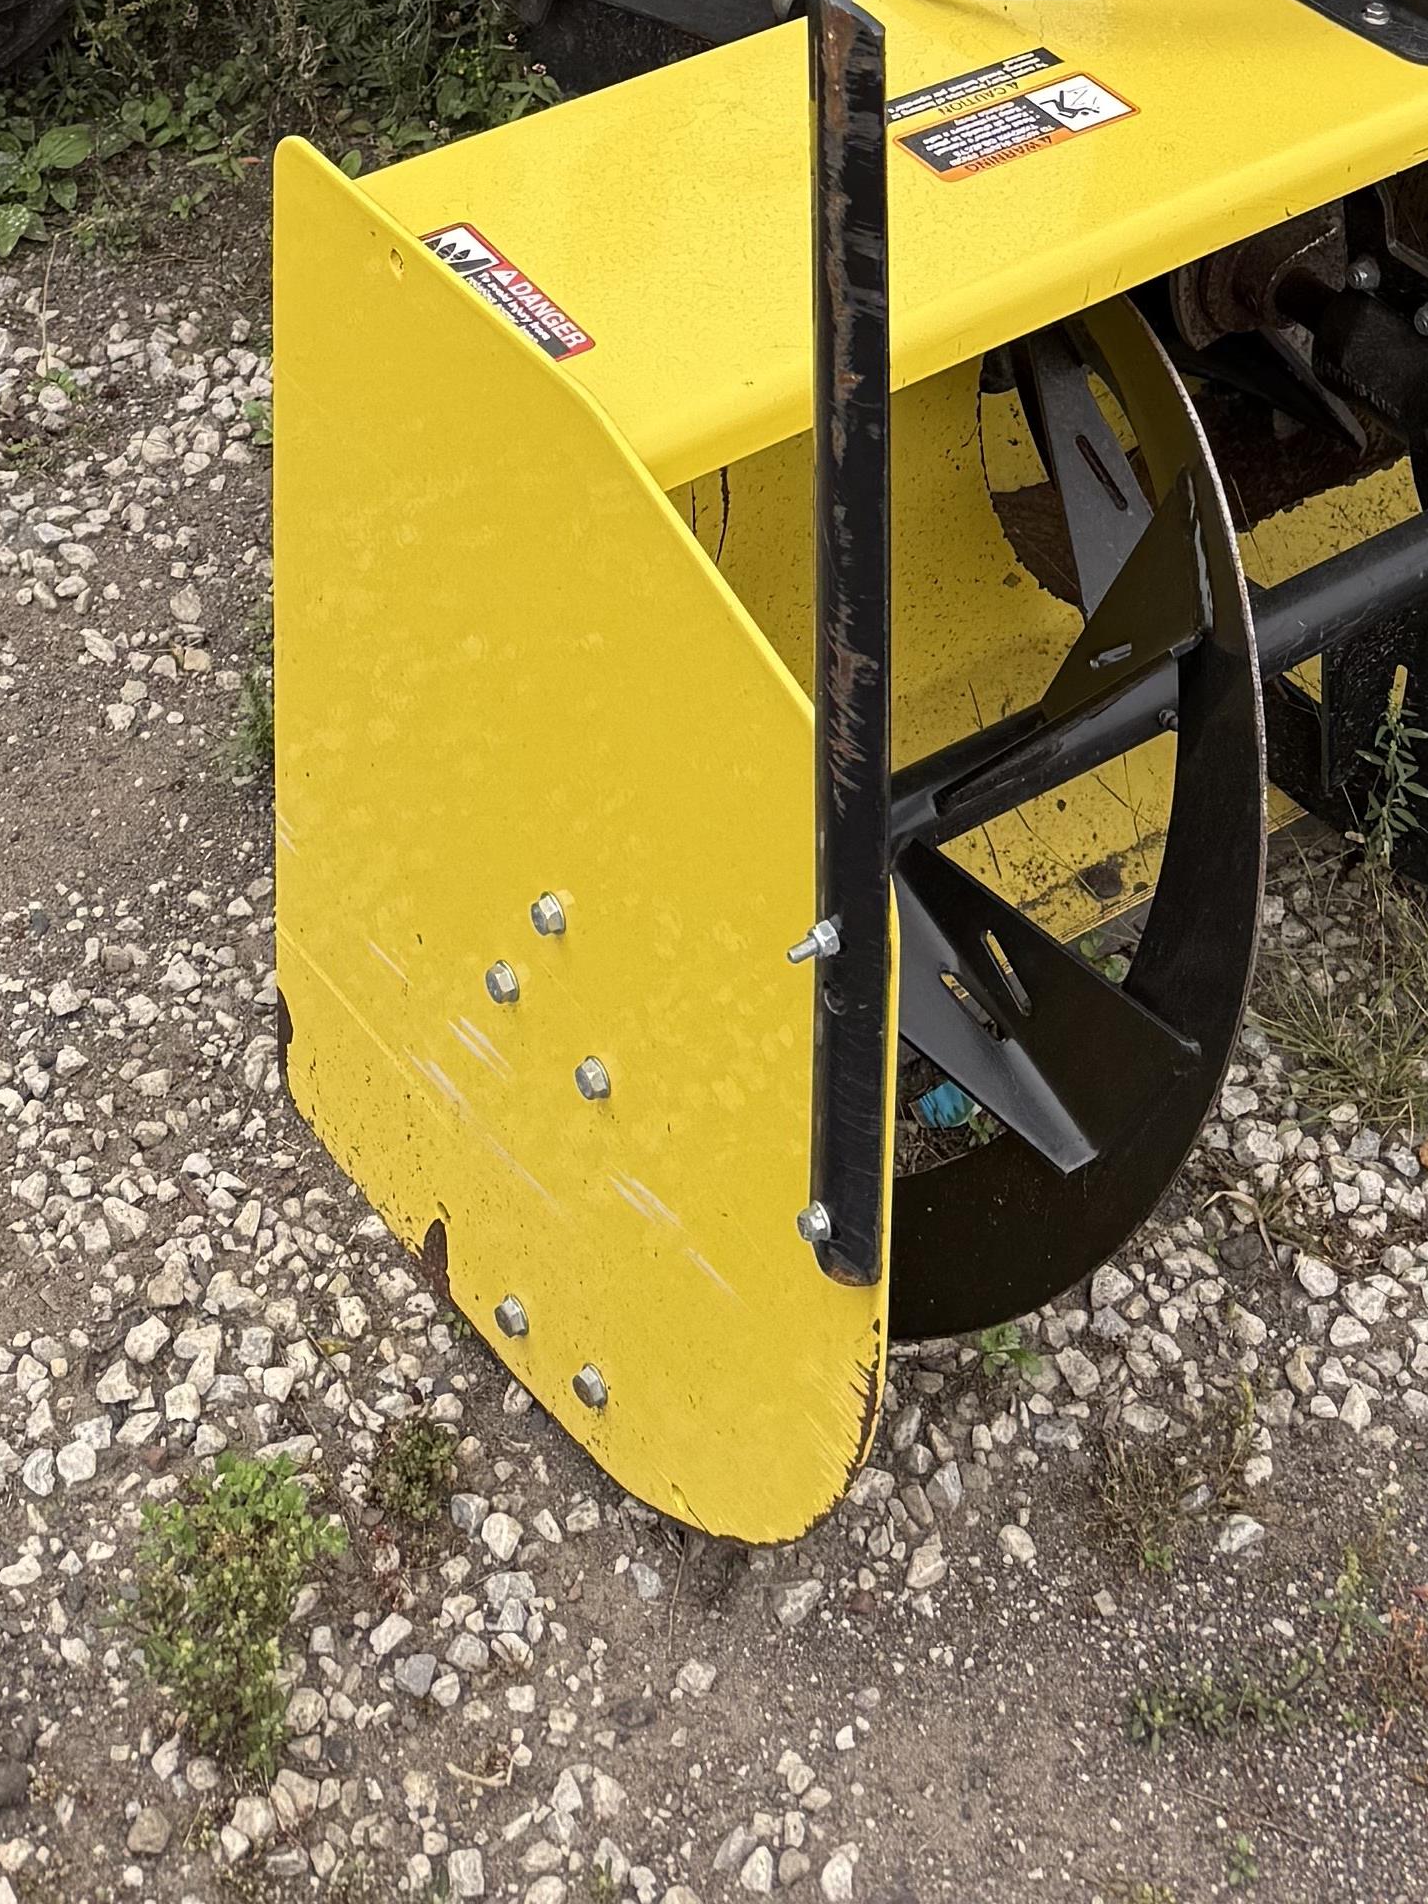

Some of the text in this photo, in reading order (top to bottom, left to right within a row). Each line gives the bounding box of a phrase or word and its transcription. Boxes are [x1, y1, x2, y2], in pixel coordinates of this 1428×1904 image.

[937, 85, 1008, 116] CAUTION
[965, 140, 1042, 173] WARNING
[507, 280, 588, 348] DANGER
